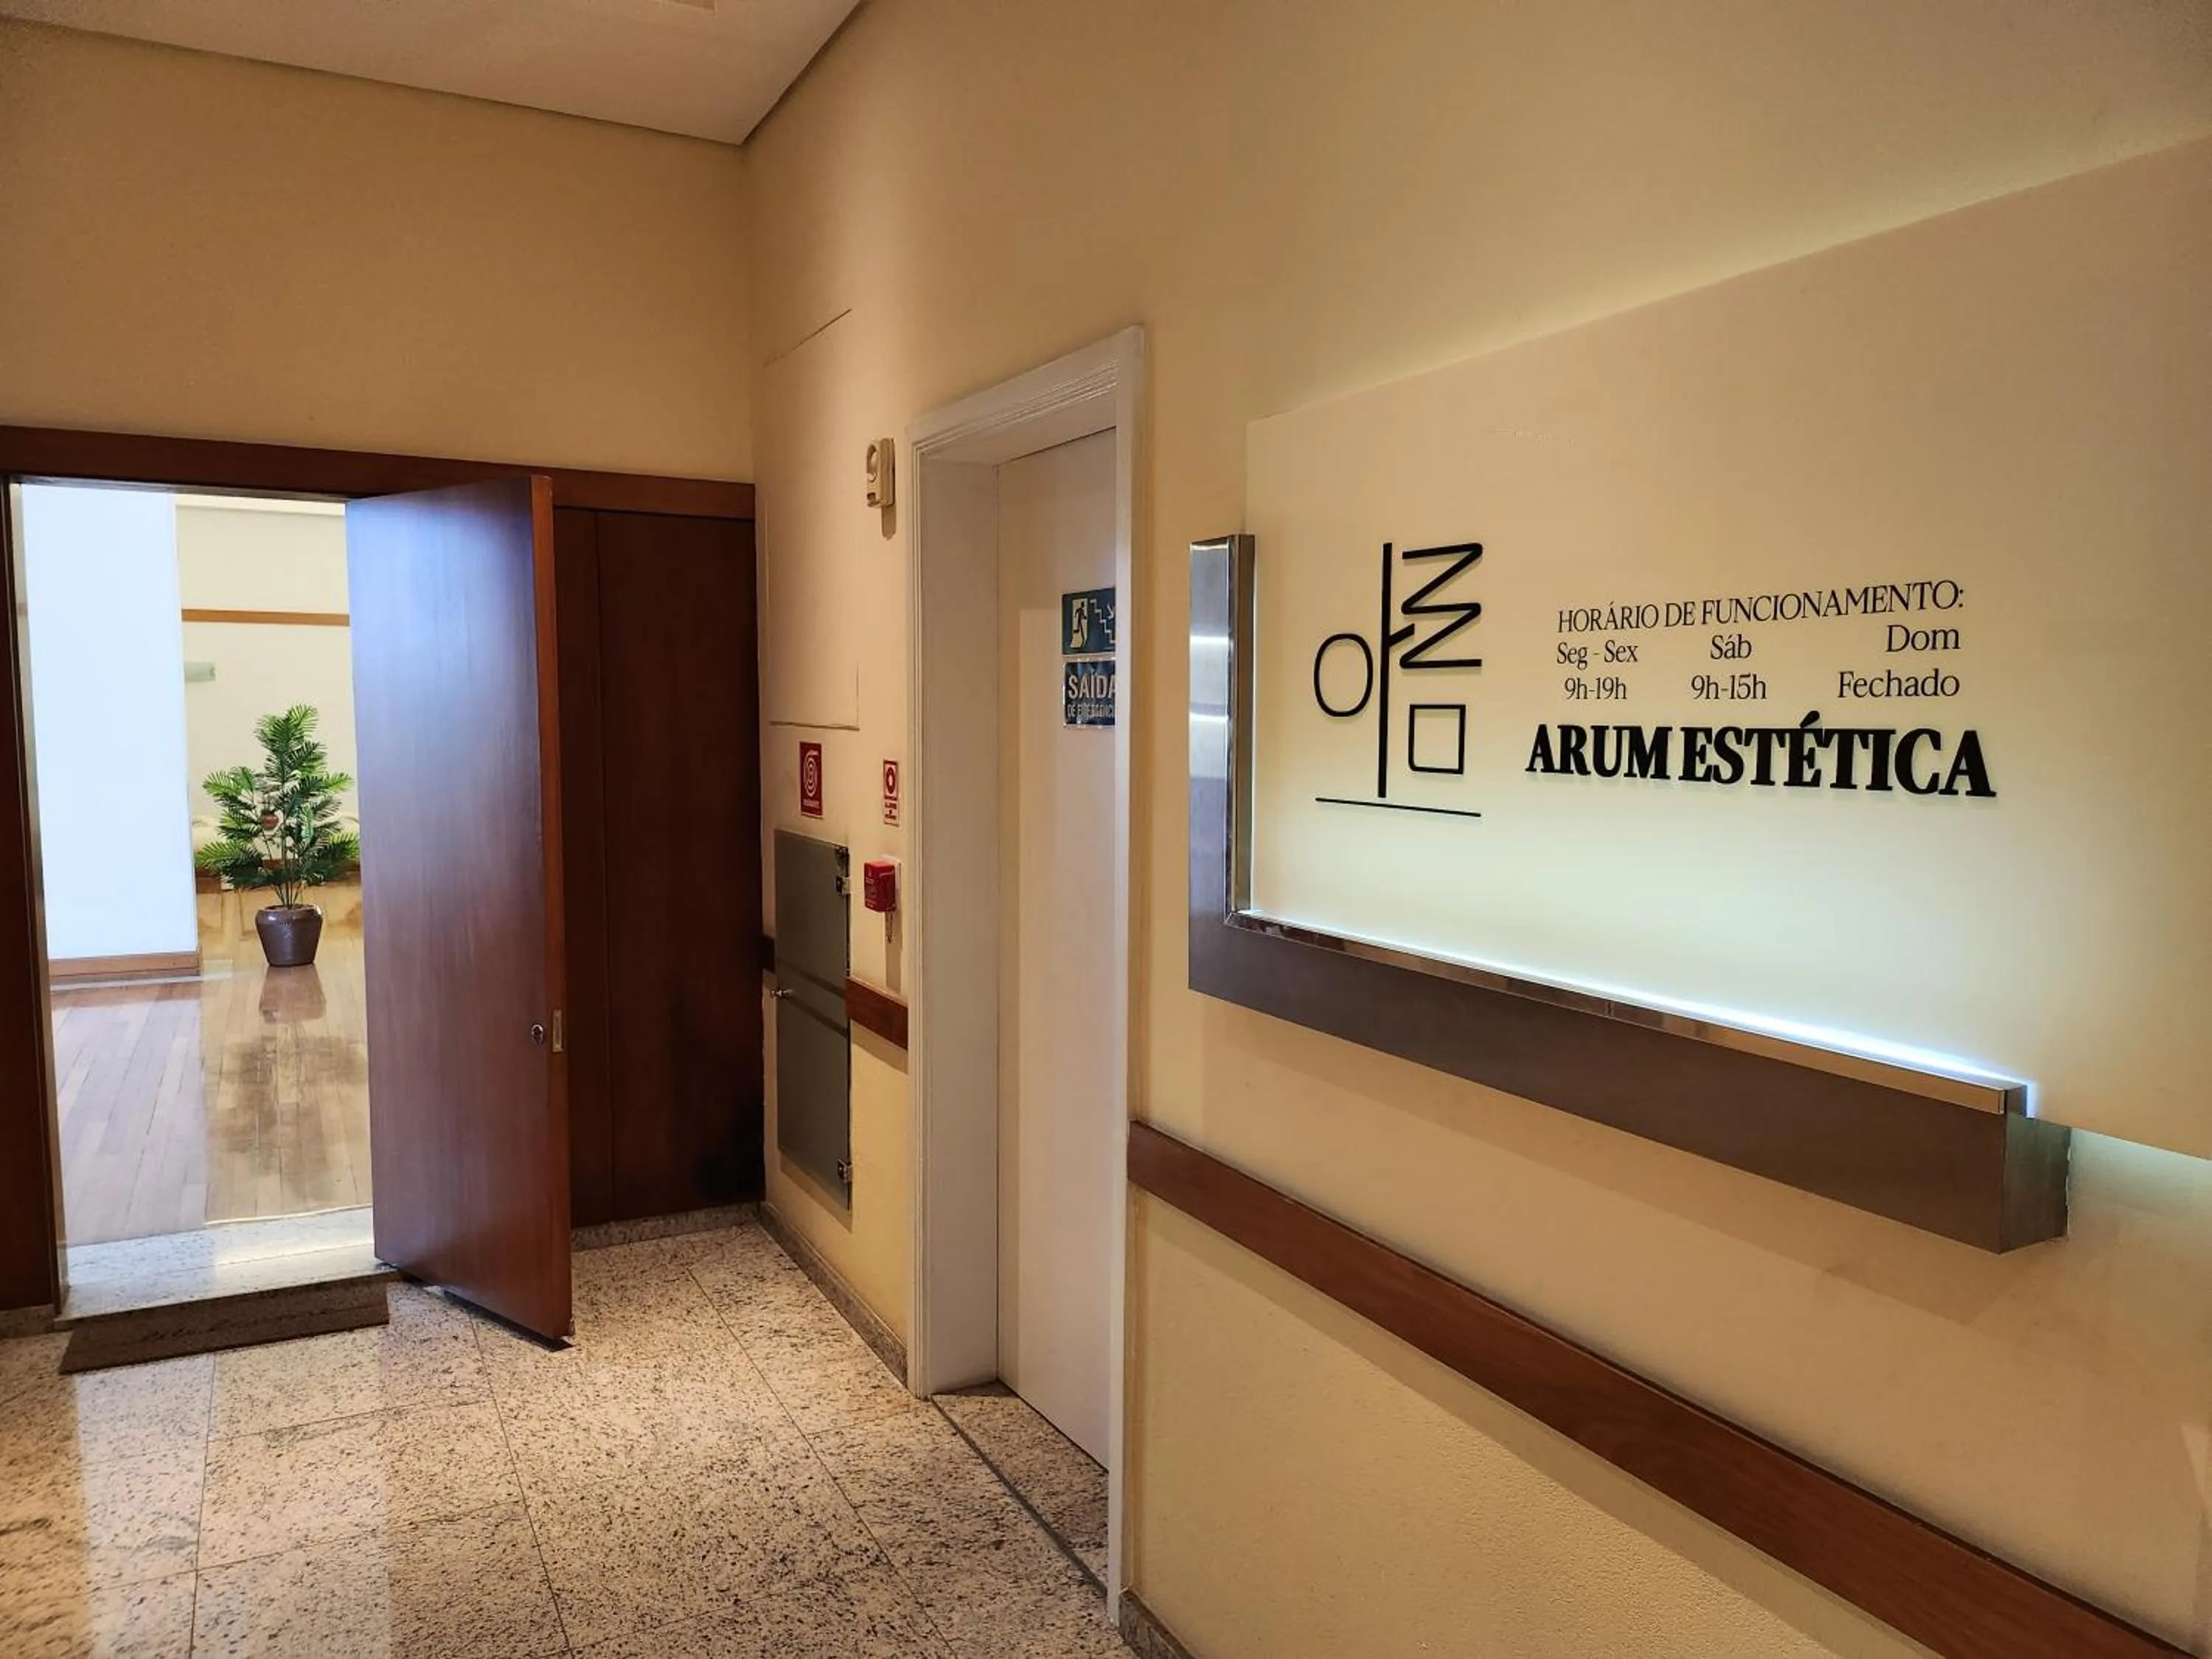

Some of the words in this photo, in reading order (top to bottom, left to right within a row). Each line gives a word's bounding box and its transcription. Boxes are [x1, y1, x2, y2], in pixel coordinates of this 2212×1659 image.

[1557, 601, 1660, 633] HORÁRIO
[1663, 601, 1697, 628] DE
[1700, 579, 1964, 626] FUNCIONAMENTO:
[1710, 633, 1753, 661] Sáb
[1885, 624, 1961, 653] Dom
[1557, 641, 1589, 672] Seg
[1603, 639, 1639, 664] Sex
[1564, 675, 1627, 700] 9h-19h
[1690, 672, 1767, 700] 9h-15h
[1837, 667, 1961, 699] Fechado
[1525, 723, 1673, 781] ARUM
[1677, 709, 1997, 798] ESTÉTICA
